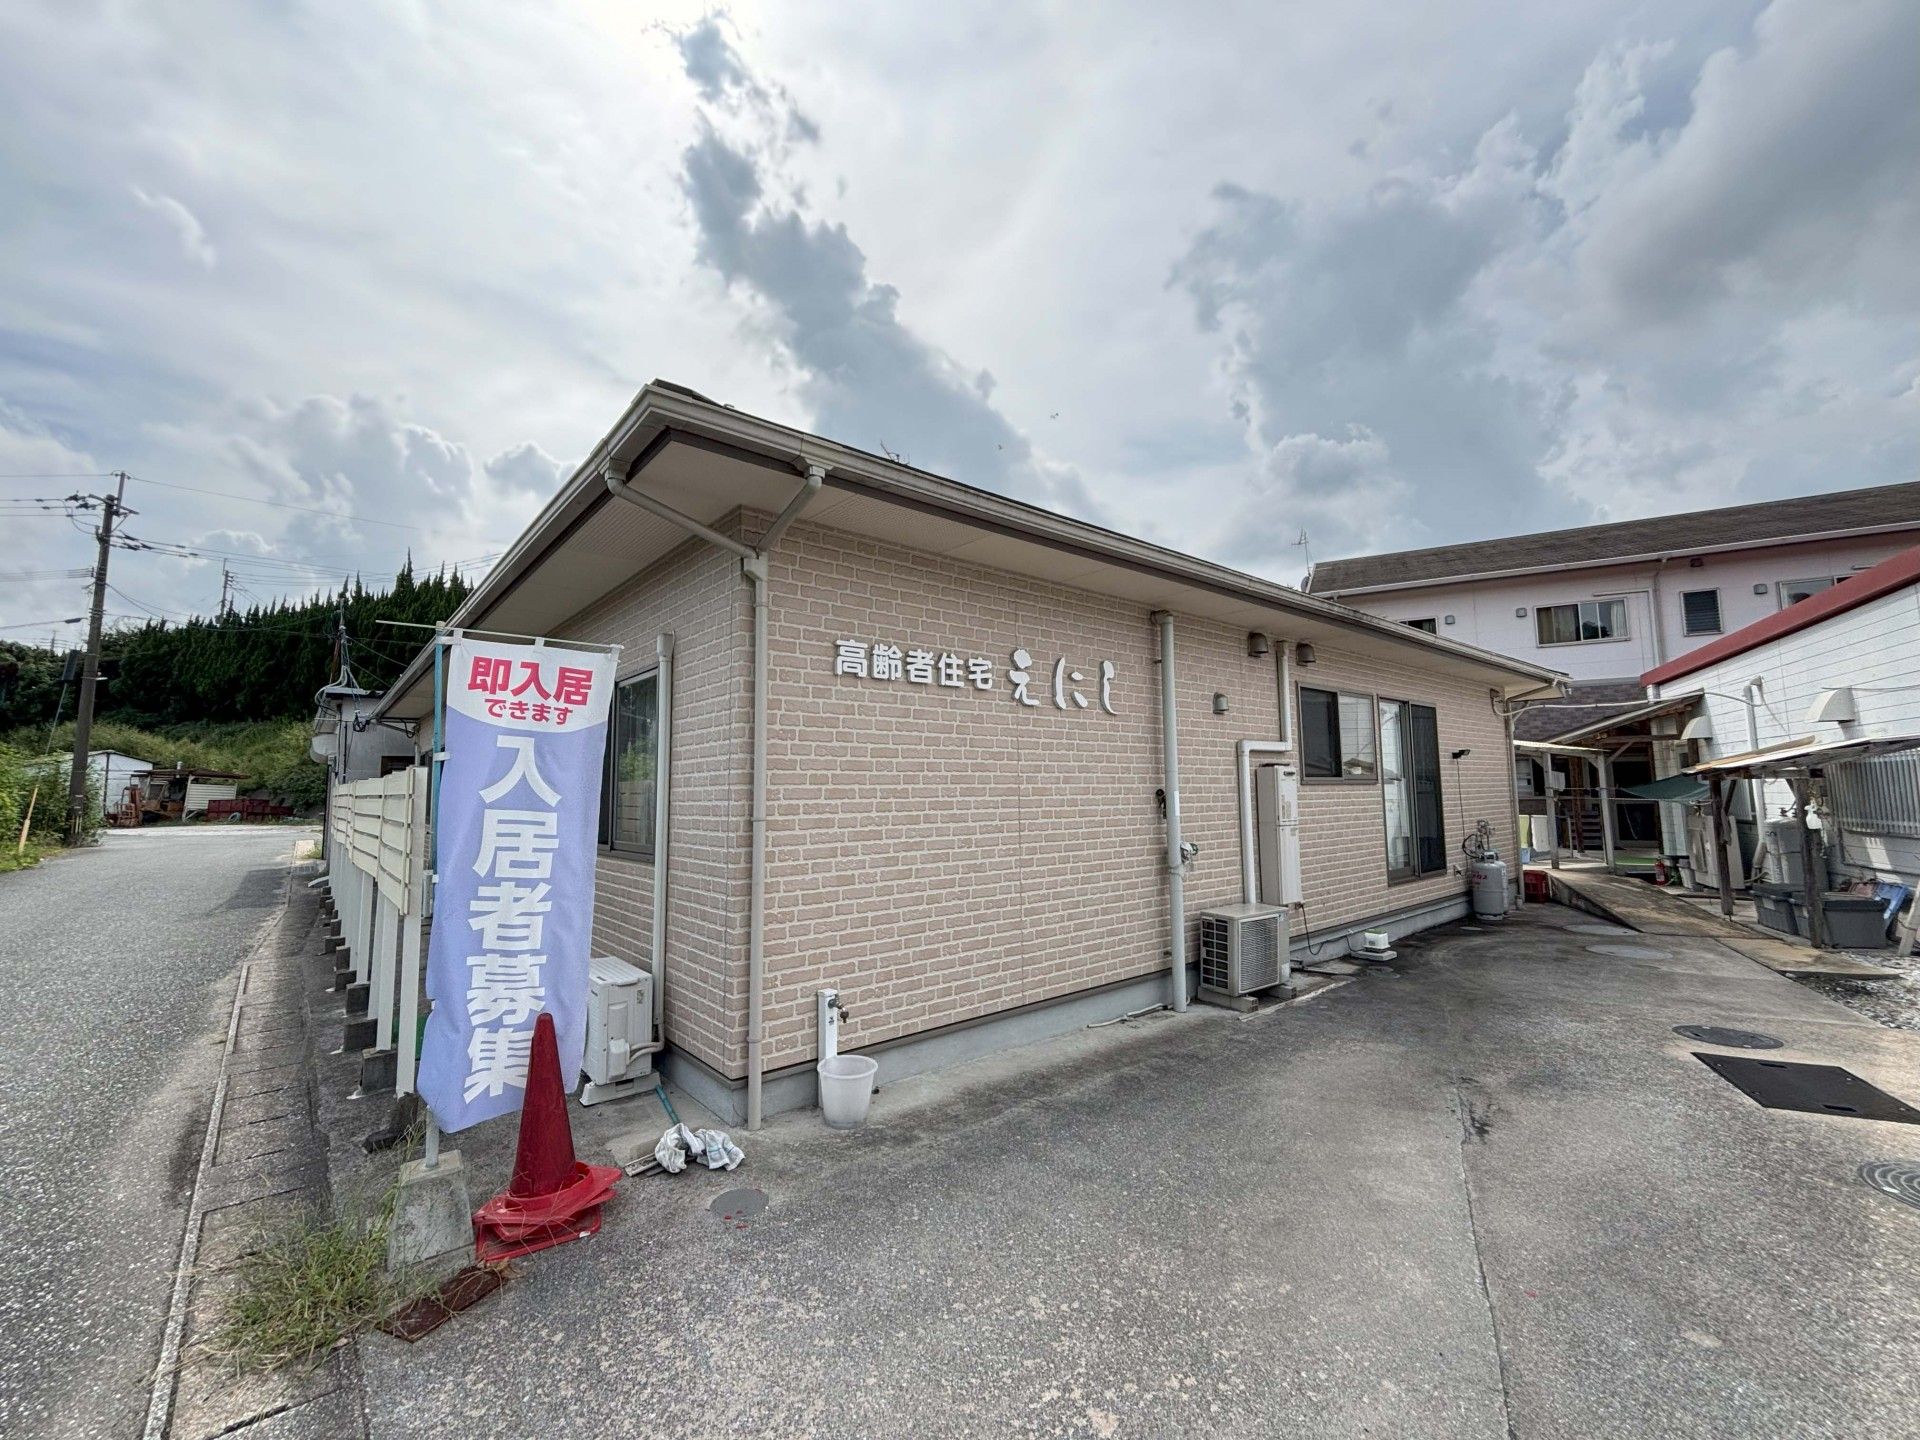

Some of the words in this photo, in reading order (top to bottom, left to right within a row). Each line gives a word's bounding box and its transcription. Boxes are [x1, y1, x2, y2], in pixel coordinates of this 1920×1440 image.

[468, 656, 593, 706] 即入居
[835, 640, 993, 690] 高齢者住宅
[1008, 648, 1118, 715] えにし
[484, 698, 573, 725] できます
[463, 735, 561, 1105] 入居者募集
